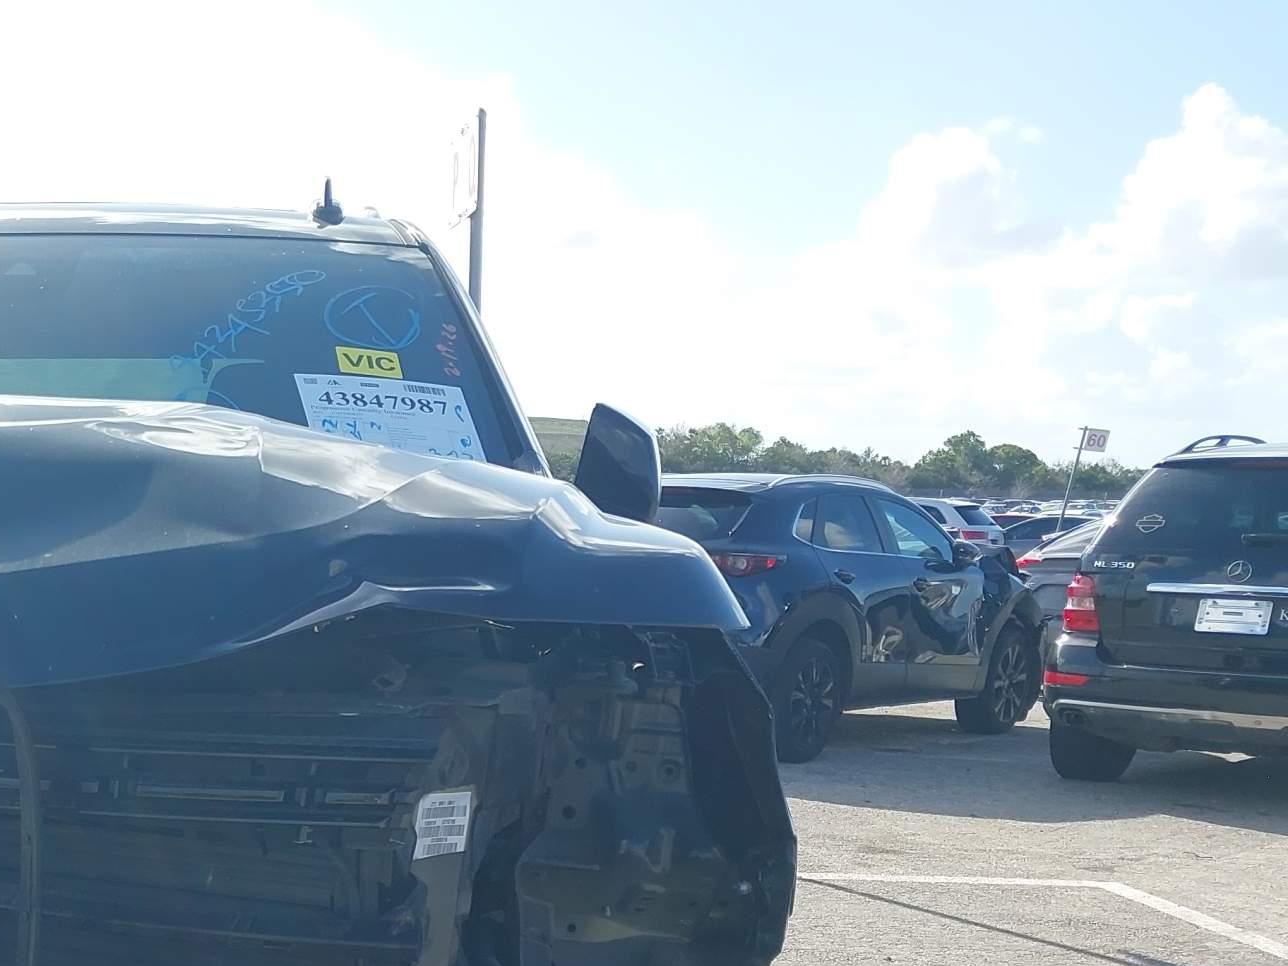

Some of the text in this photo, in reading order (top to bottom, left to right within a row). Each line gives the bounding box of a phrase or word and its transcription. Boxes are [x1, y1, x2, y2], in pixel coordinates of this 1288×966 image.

[342, 352, 396, 372] VIC
[318, 390, 448, 415] 43847987
[1087, 433, 1107, 448] 60
[1111, 561, 1136, 569] 350
